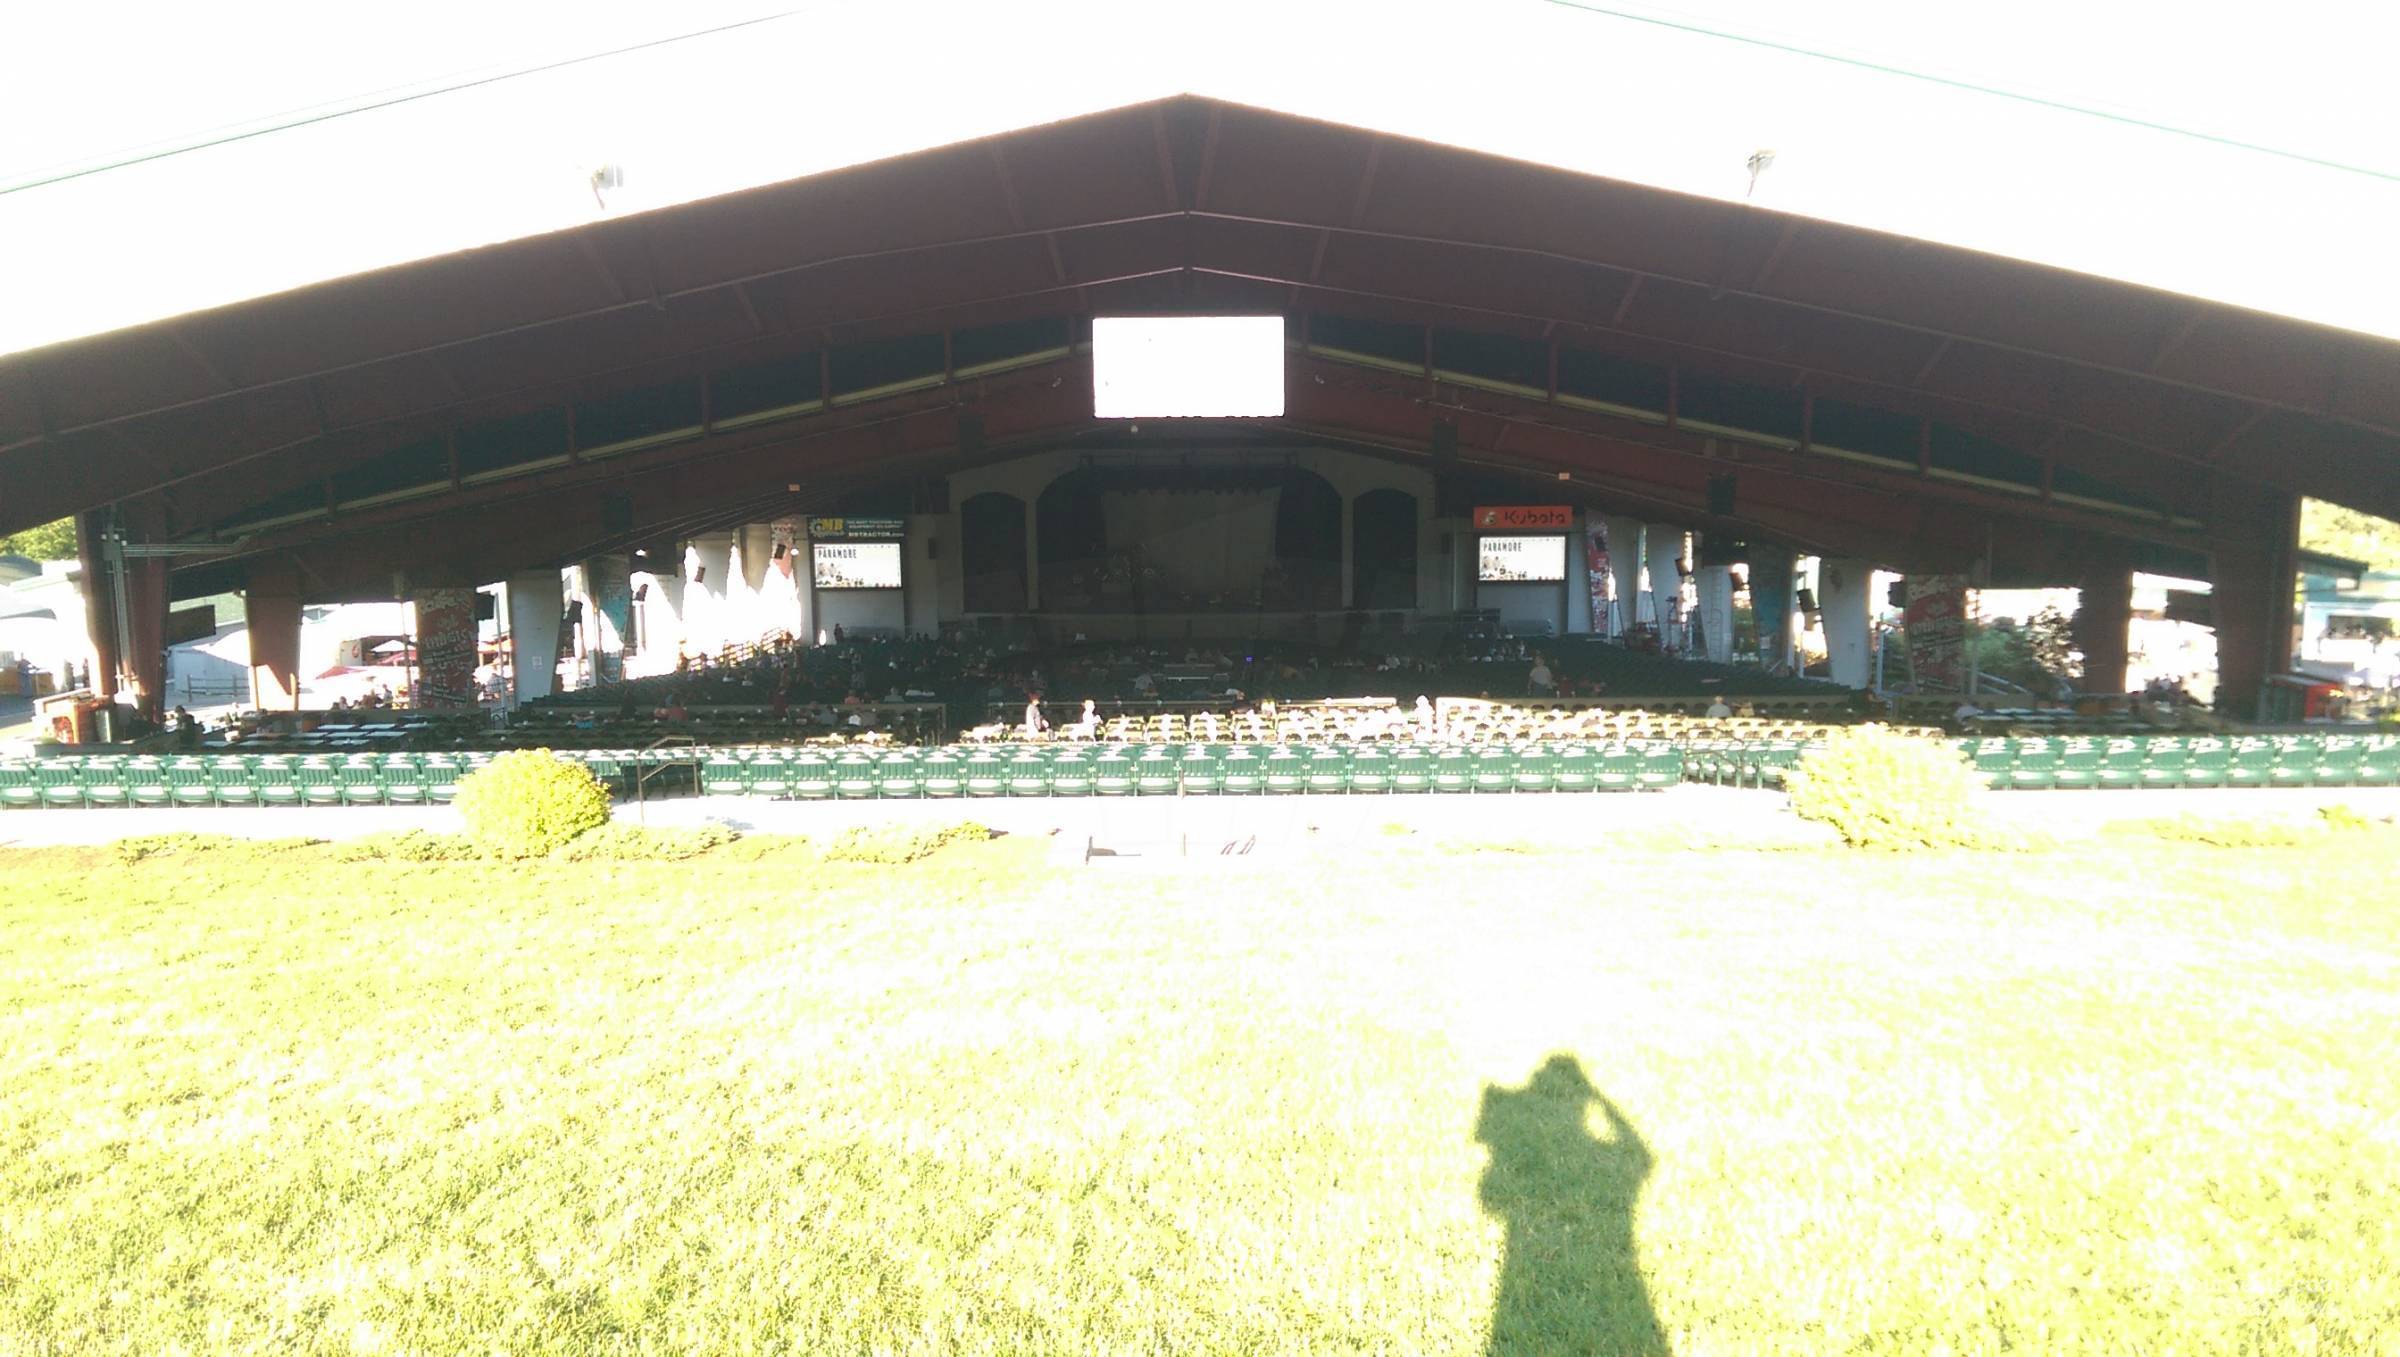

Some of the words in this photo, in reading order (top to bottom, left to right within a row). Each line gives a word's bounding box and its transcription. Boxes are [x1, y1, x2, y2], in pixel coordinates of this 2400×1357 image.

[1504, 510, 1566, 525] Kubota
[1483, 542, 1523, 553] PARAMORE
[818, 548, 858, 559] PARAMORE
